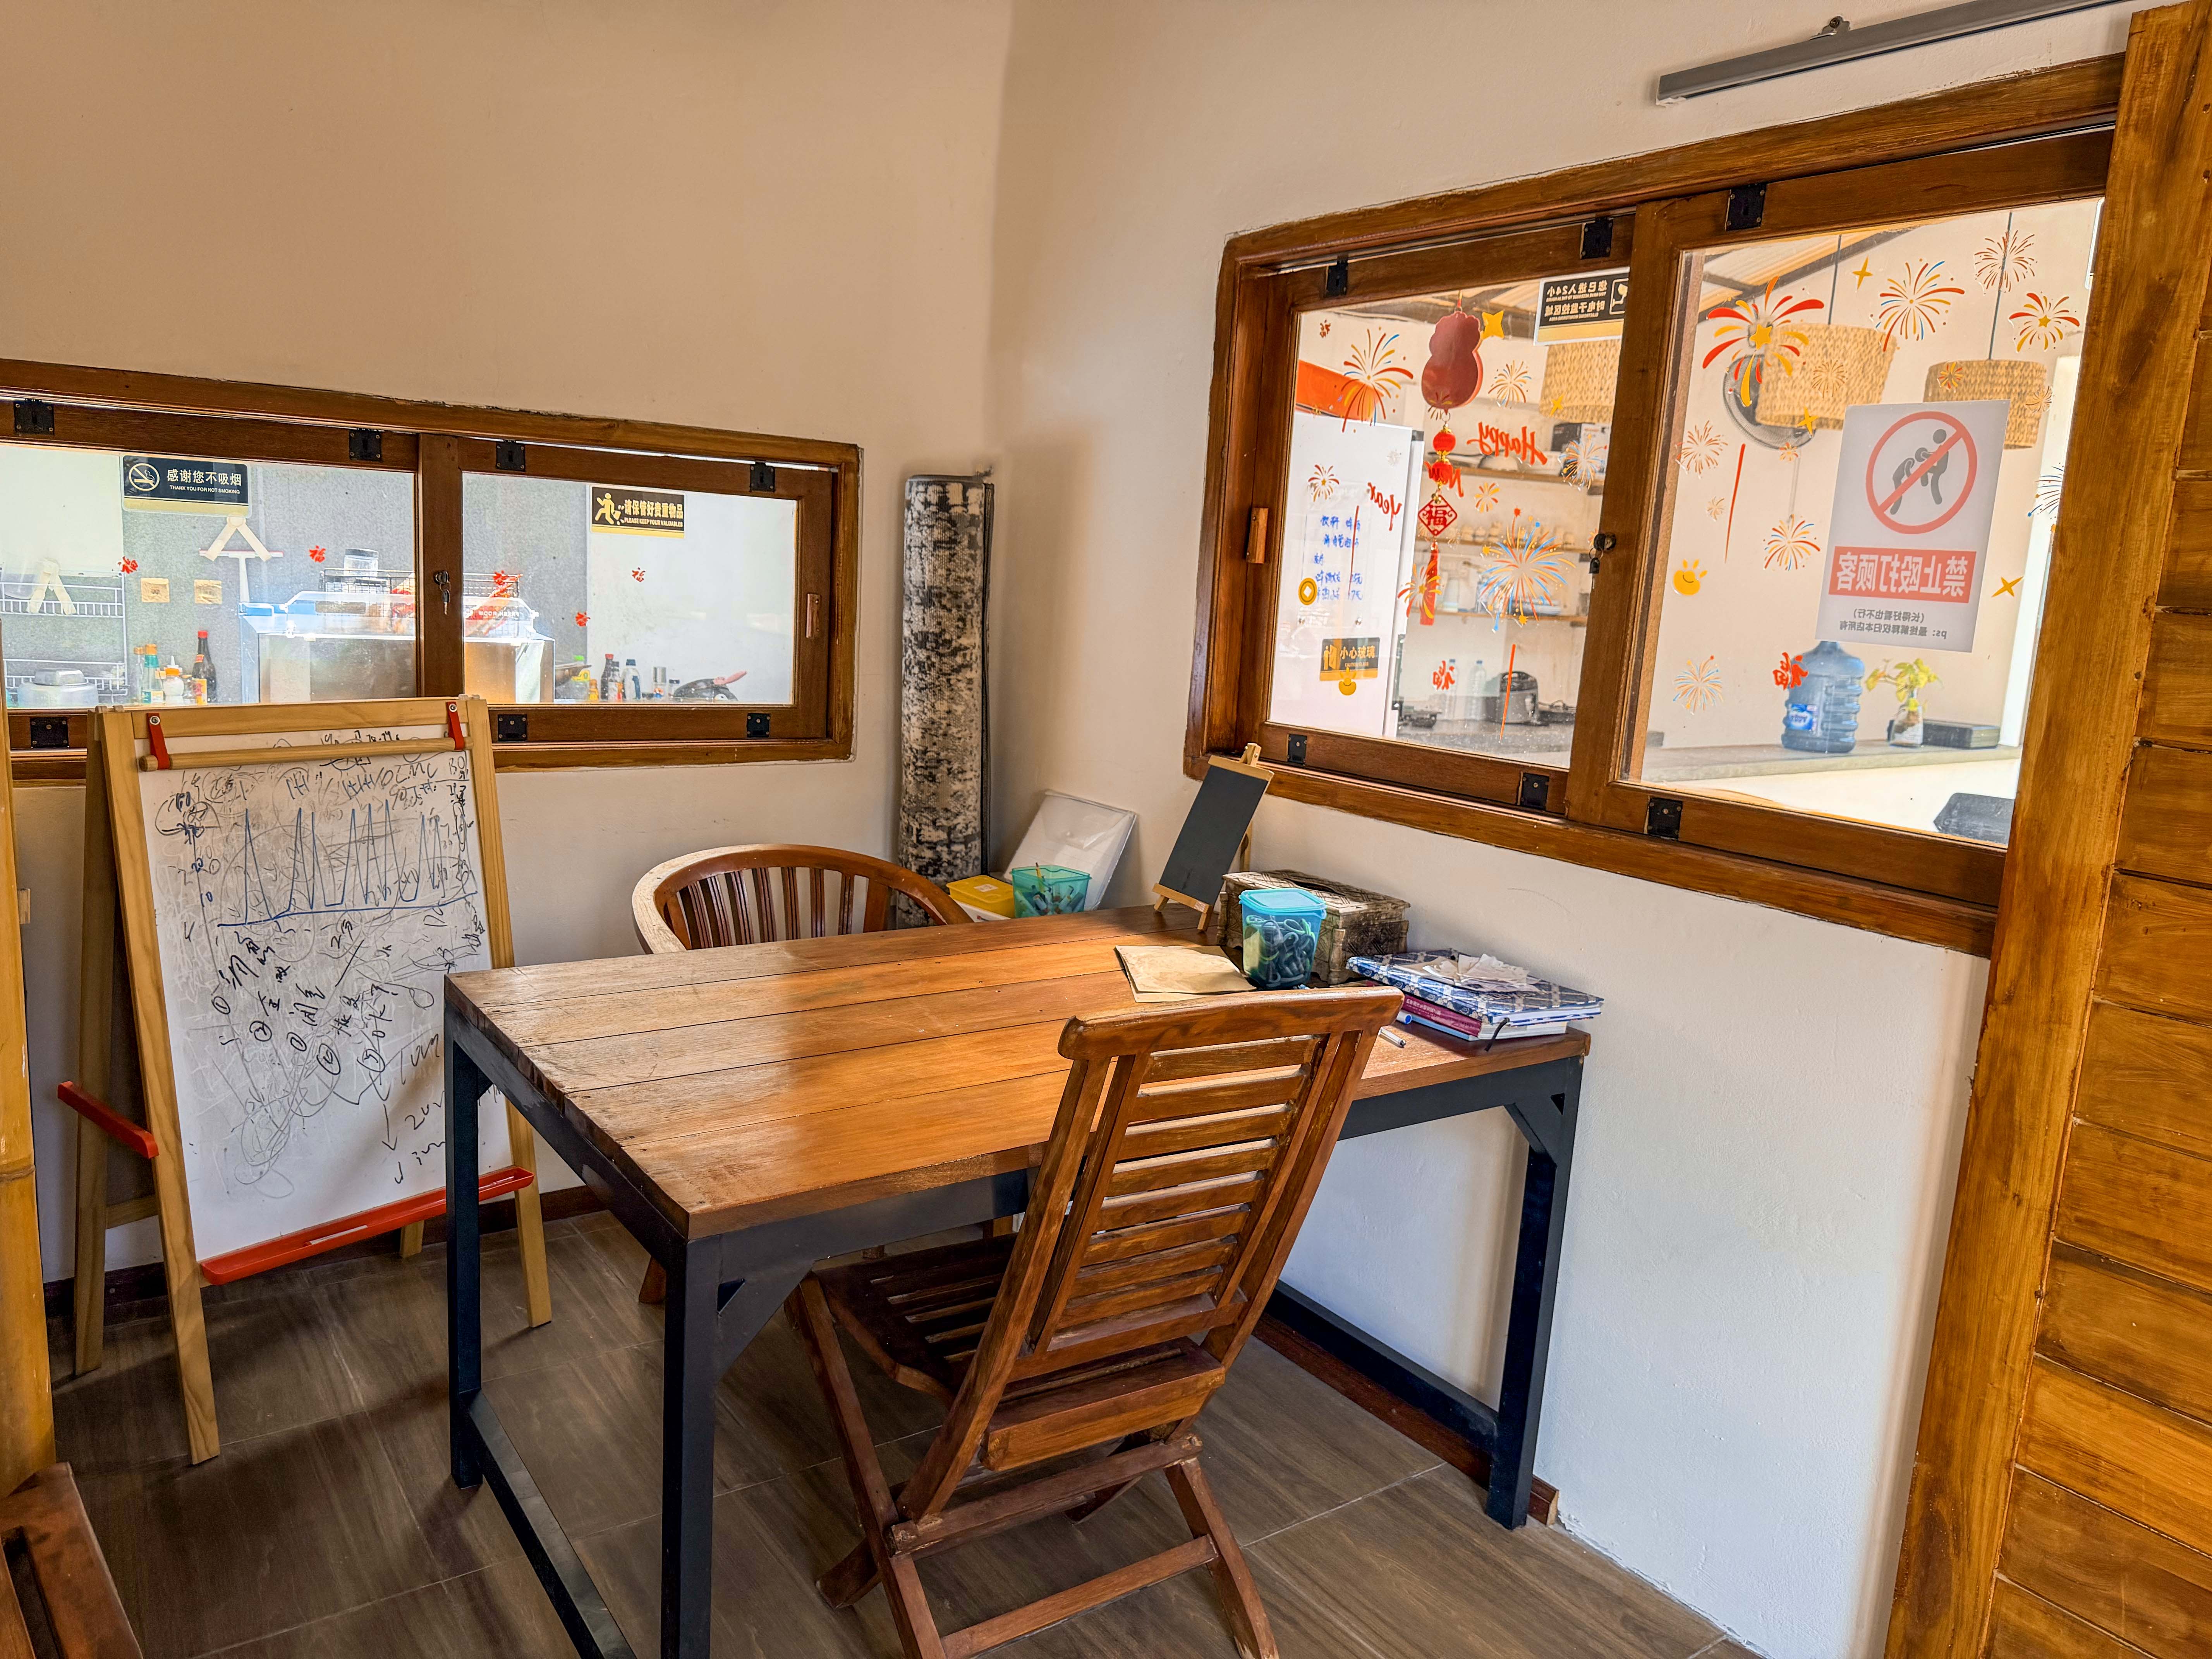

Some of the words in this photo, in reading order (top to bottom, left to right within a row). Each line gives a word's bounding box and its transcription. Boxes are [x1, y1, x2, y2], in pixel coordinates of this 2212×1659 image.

[167, 468, 242, 486] 感谢您不吸烟
[624, 499, 683, 519] 请保管好贵重物品
[1426, 505, 1447, 526] 福
[1340, 645, 1375, 659] 小心玻璃
